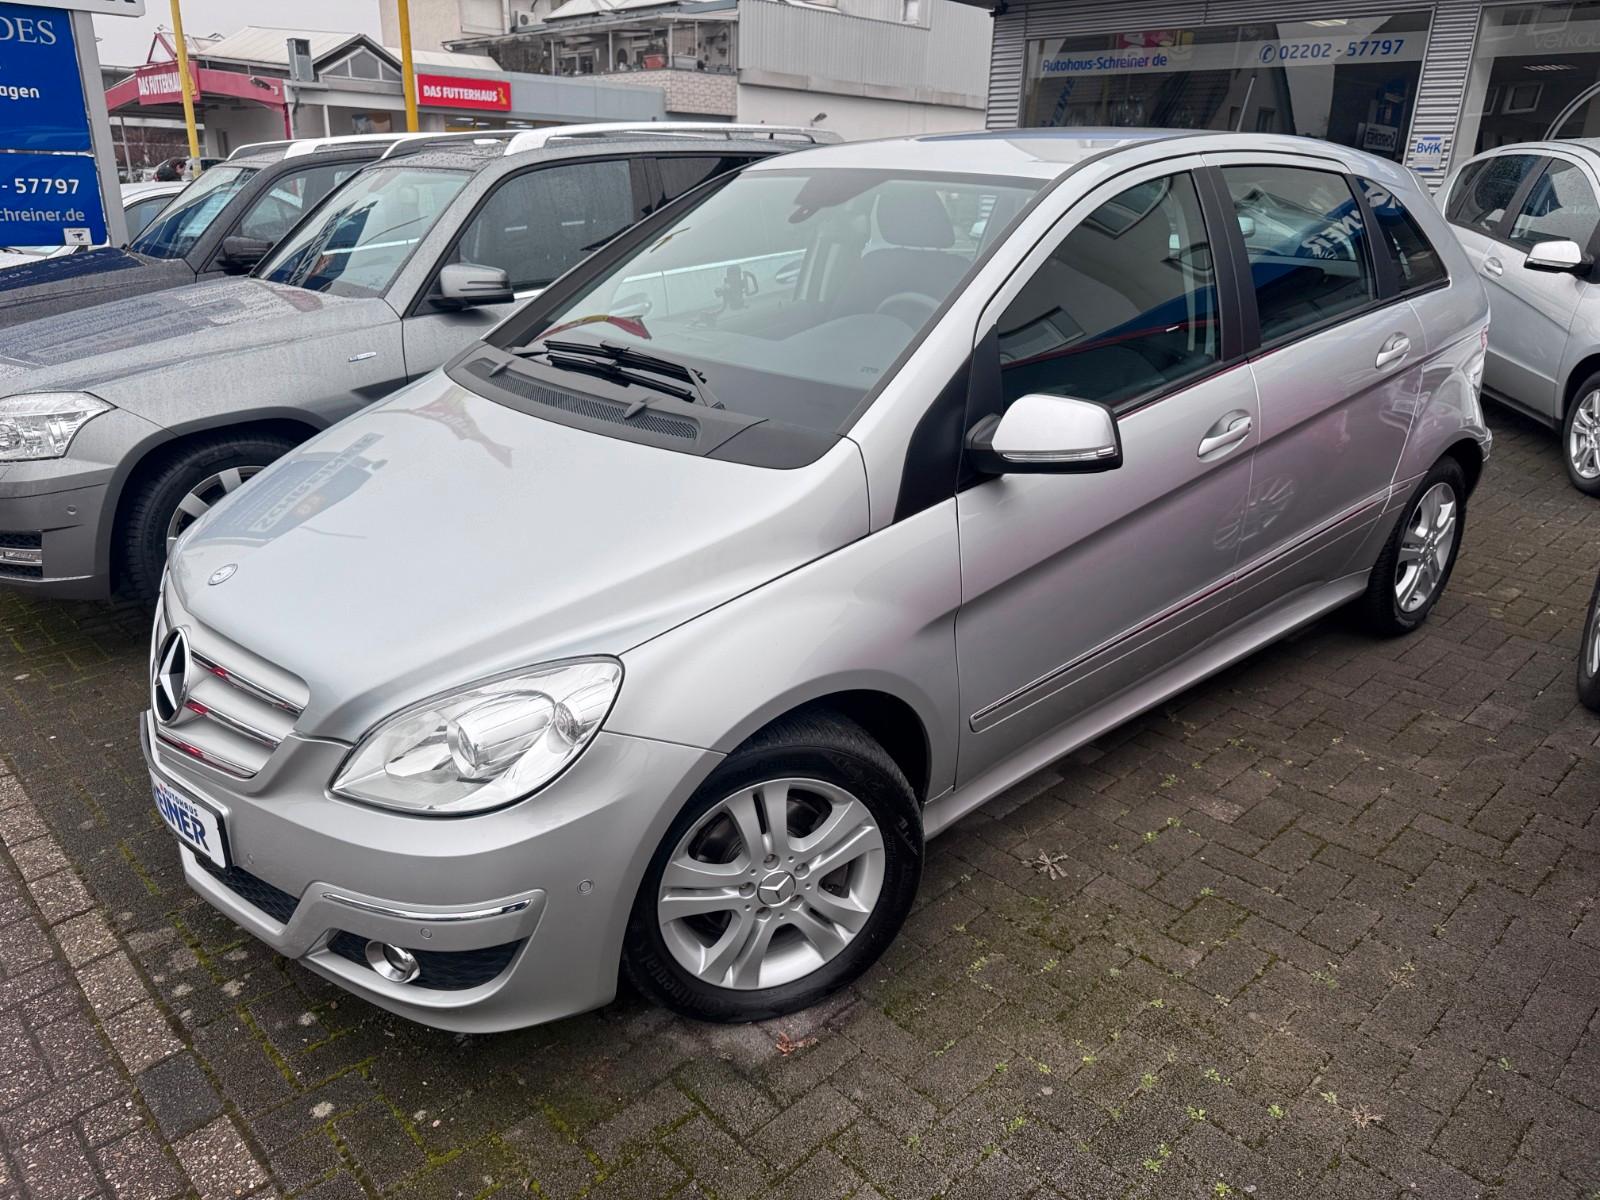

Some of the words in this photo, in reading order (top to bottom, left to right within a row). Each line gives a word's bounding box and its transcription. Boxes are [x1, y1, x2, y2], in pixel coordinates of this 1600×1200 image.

[1279, 43, 1332, 60] 02202
[1347, 39, 1404, 57] 57797
[149, 72, 183, 95] FUTTERHAU
[423, 85, 441, 98] DAS
[442, 87, 497, 102] FUTTERHAUS
[14, 178, 79, 194] 57797
